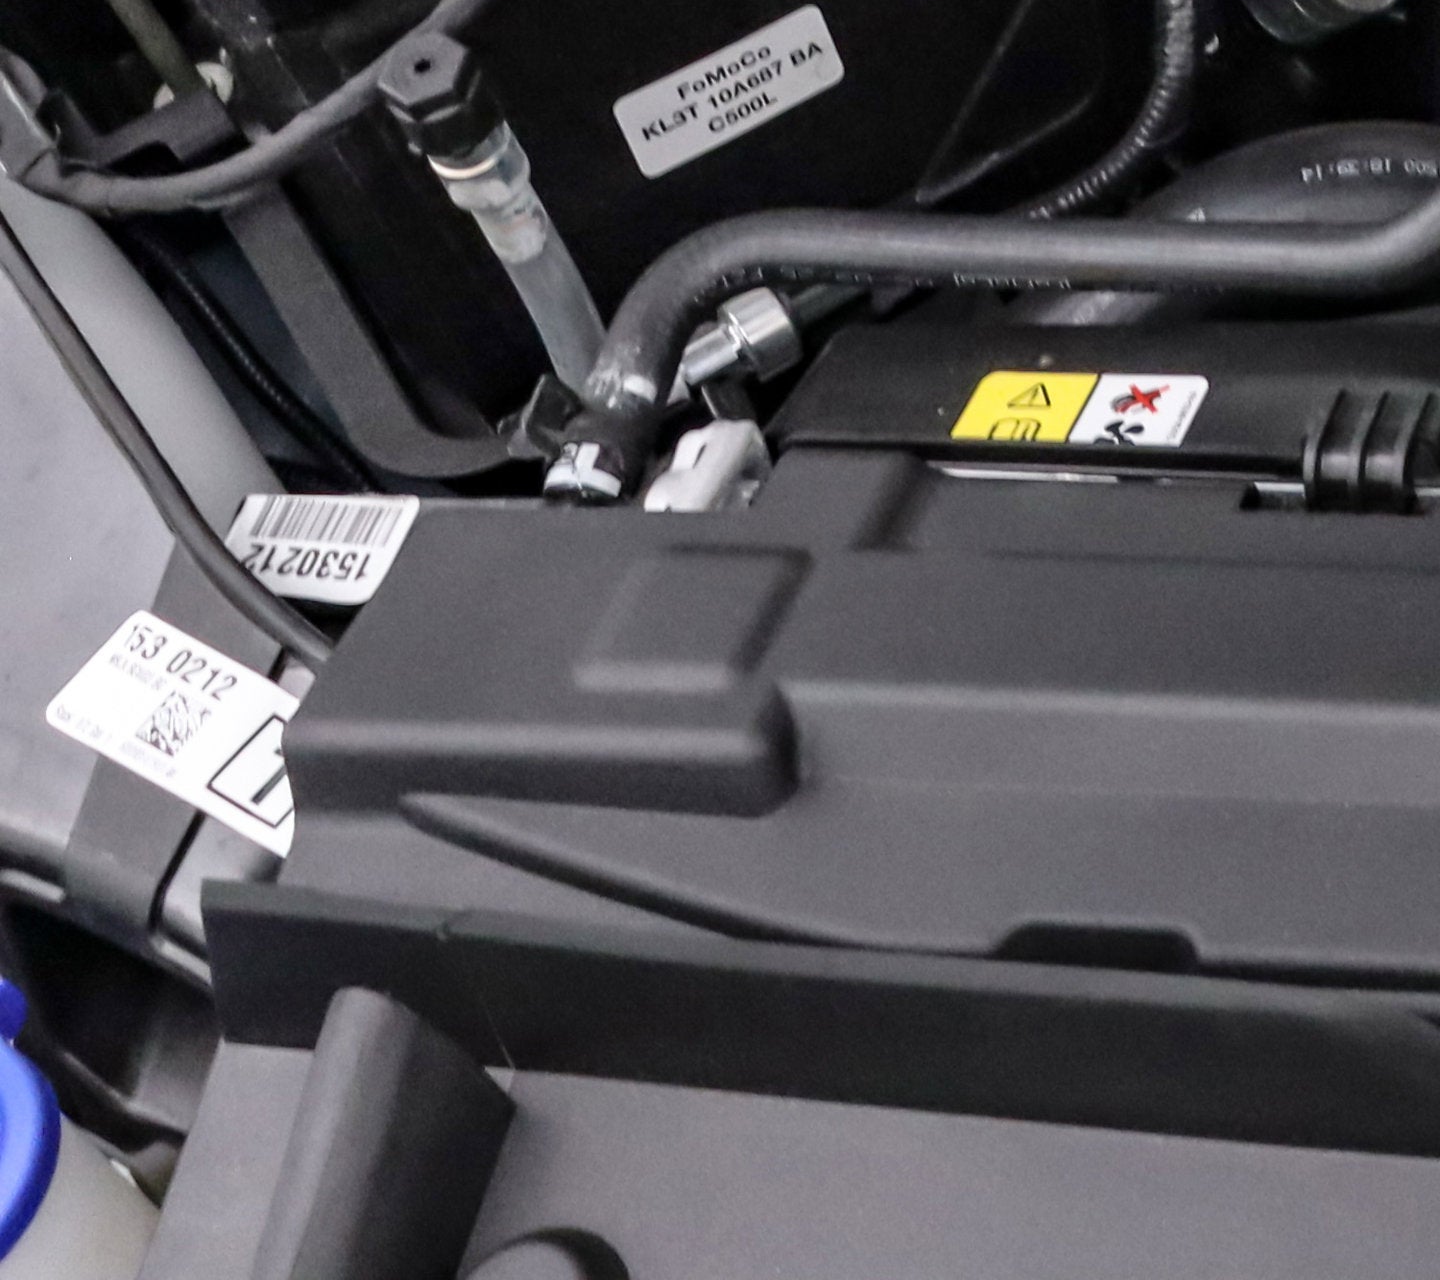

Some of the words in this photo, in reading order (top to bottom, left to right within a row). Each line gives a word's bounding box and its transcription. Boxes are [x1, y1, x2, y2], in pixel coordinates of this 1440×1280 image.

[641, 102, 699, 142] KL3T
[789, 42, 824, 68] BA
[677, 46, 771, 100] FoMoCo
[708, 92, 779, 132] C500L
[242, 544, 371, 581] 1530212
[124, 623, 168, 660] 153
[165, 649, 238, 701] 0212
